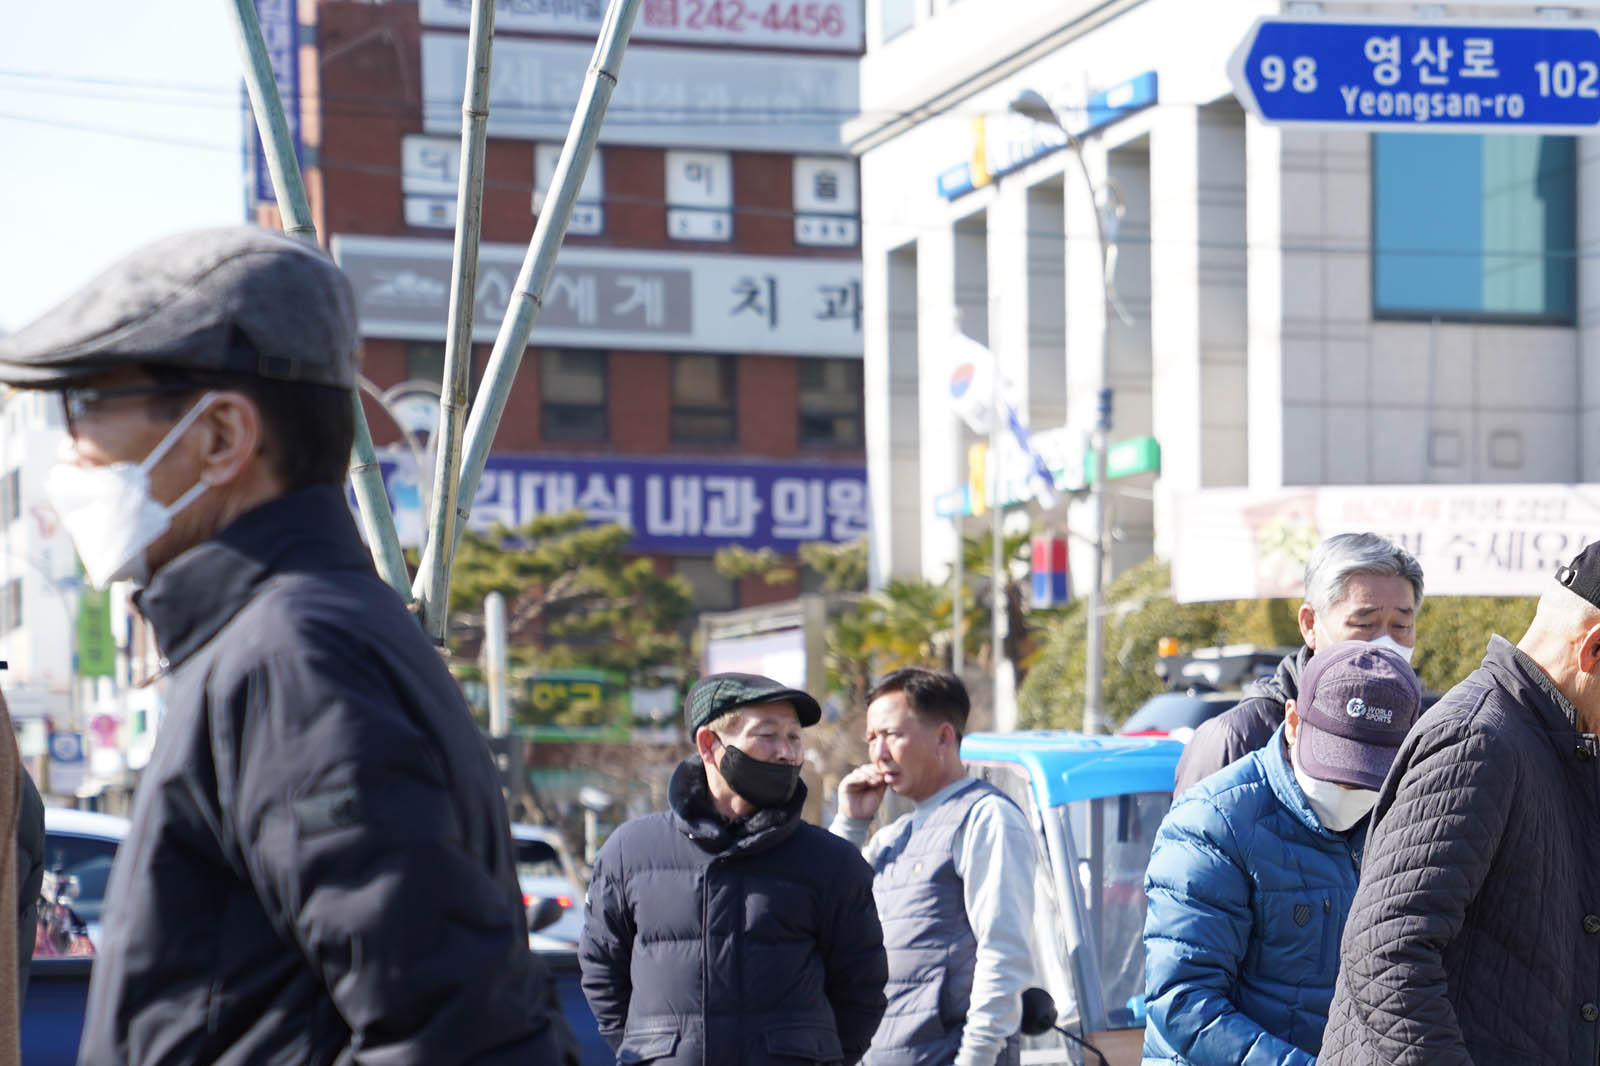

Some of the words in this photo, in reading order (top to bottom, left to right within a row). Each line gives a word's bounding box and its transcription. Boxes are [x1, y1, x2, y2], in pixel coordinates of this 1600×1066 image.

[686, 0, 845, 36] 242-4456
[1260, 56, 1318, 93] 98
[1364, 36, 1499, 86] 영산로
[1534, 62, 1600, 98] 102
[1340, 86, 1525, 121] Yeongsan-ro
[729, 273, 865, 331] 치과
[646, 474, 764, 538] 내과
[1365, 712, 1392, 724] SPORTS
[1367, 705, 1393, 718] WORLD
